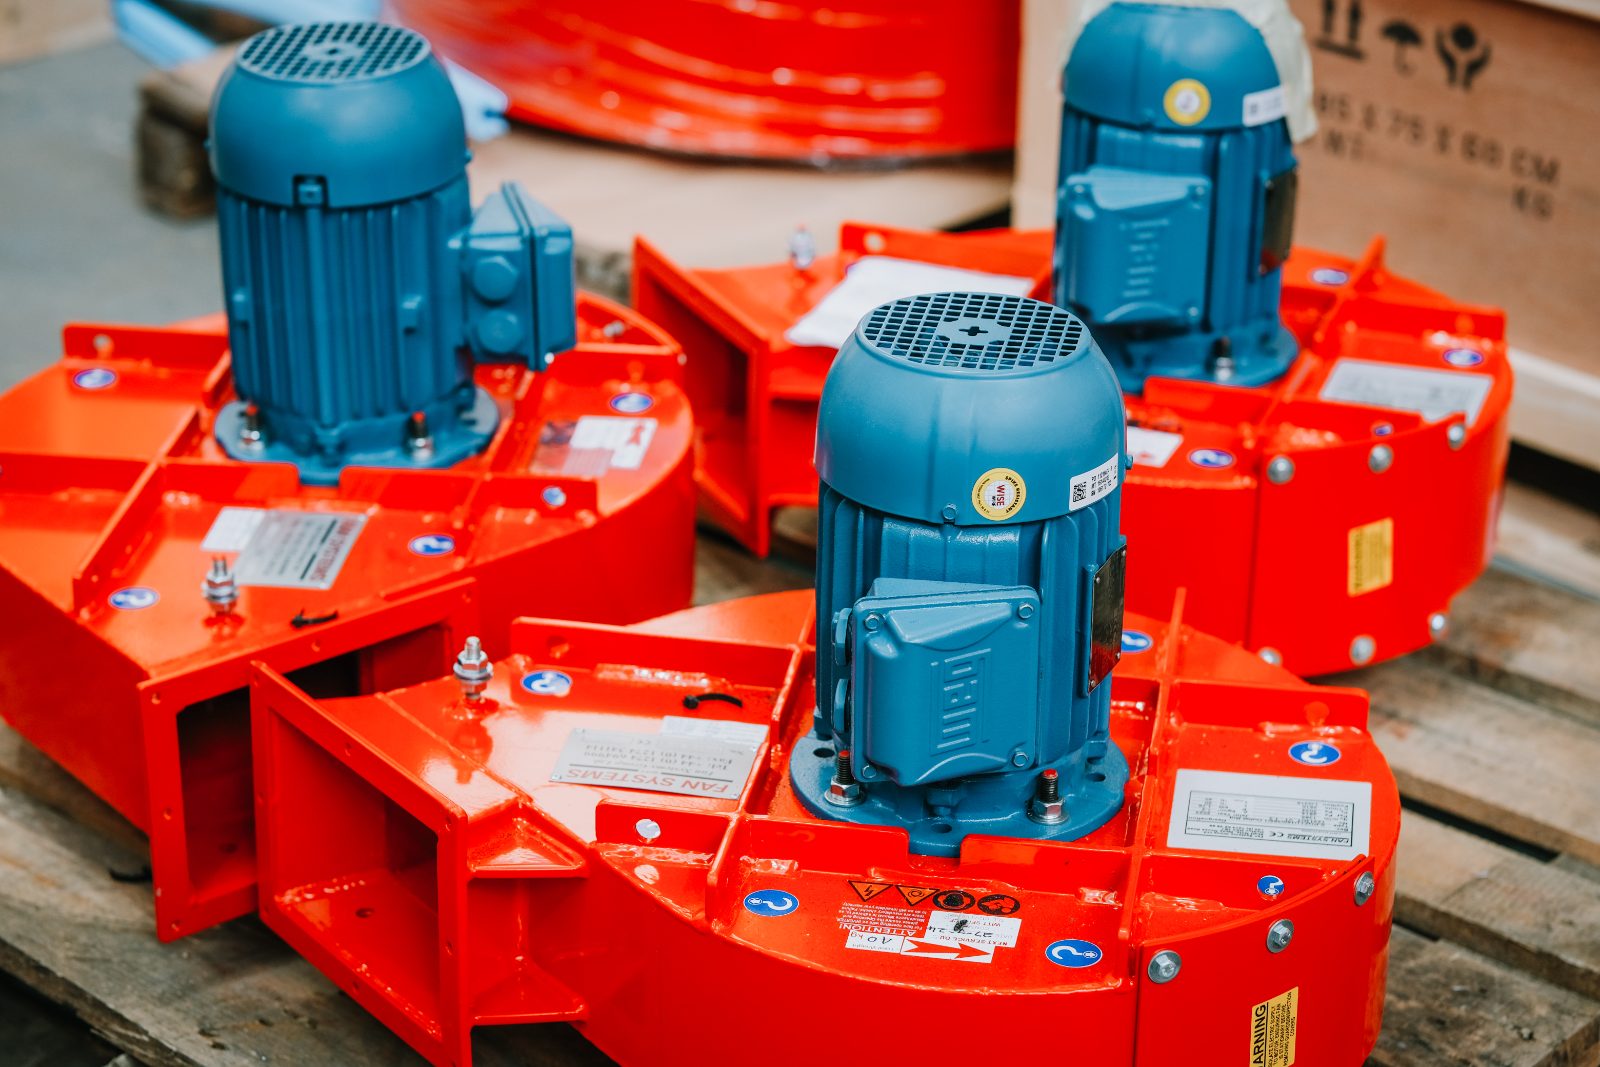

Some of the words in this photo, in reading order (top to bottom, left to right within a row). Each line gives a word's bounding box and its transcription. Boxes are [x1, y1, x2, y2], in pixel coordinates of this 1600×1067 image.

[1511, 146, 1560, 184] CM
[997, 485, 1005, 506] WISE
[566, 768, 675, 786] SYSTEMS
[681, 779, 728, 794] FAN
[1287, 834, 1329, 842] SYSTEMS
[839, 924, 916, 936] ATTENTION!
[1253, 1004, 1266, 1067] ARNING
